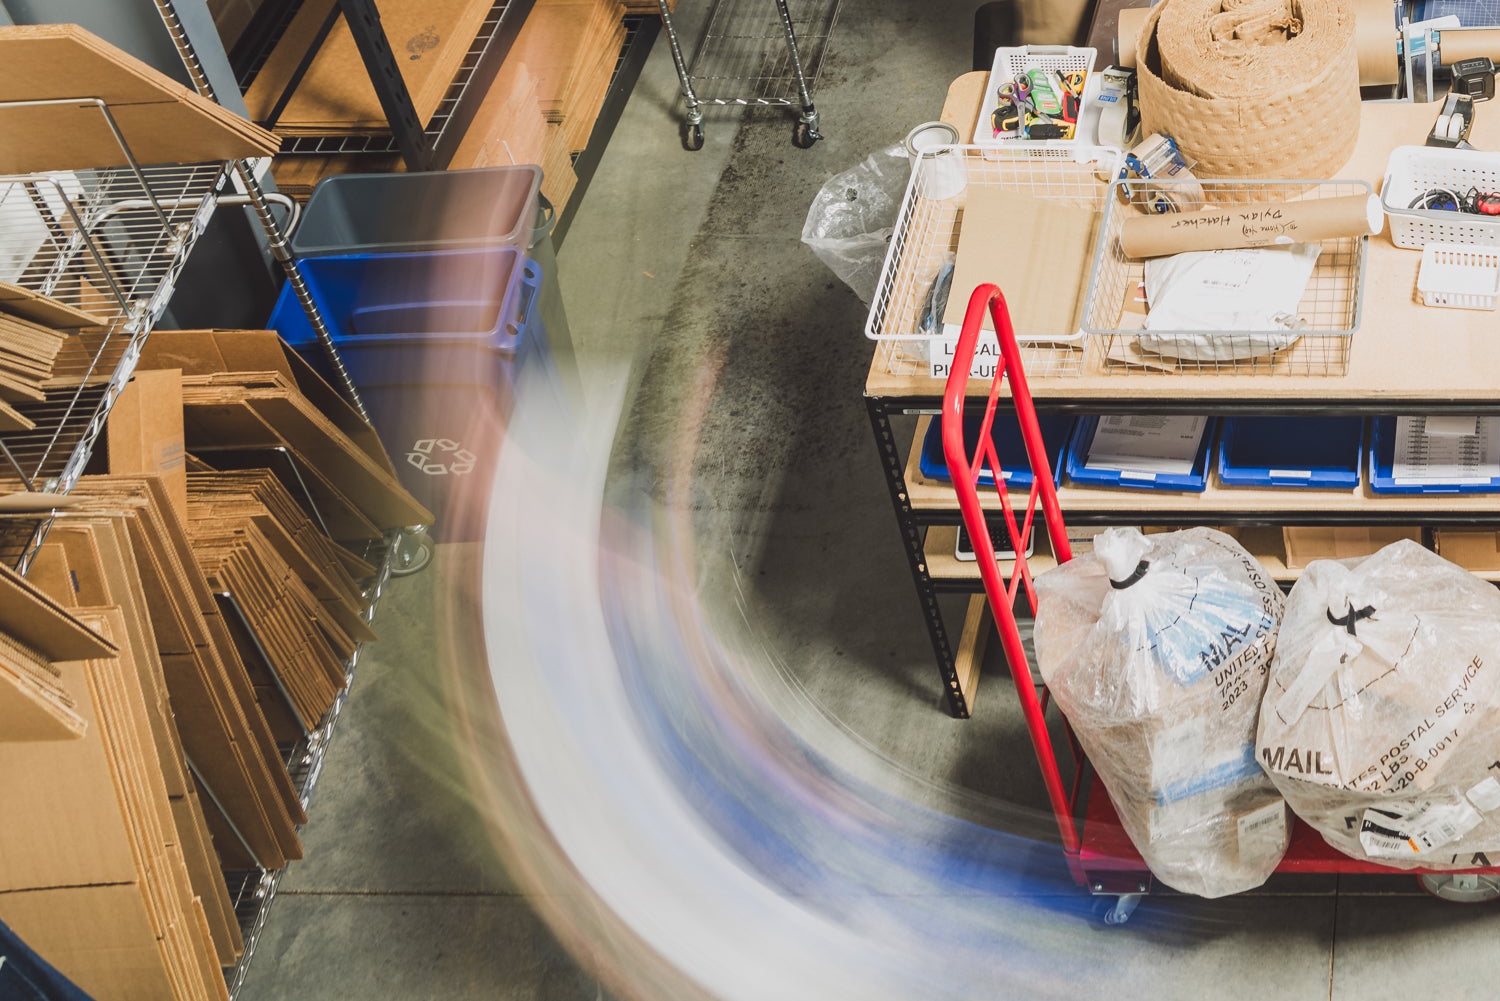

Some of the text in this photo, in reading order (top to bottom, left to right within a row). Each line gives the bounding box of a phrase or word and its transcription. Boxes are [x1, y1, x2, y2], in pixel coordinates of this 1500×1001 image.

[1171, 210, 1282, 229] Dylan Hatcher
[945, 343, 1001, 356] LAL
[1215, 643, 1258, 687] UNITED
[1222, 681, 1248, 711] 2023
[1379, 718, 1435, 766] POSTAL
[1435, 655, 1484, 718] SERVICE
[1261, 746, 1333, 775] MAIL
